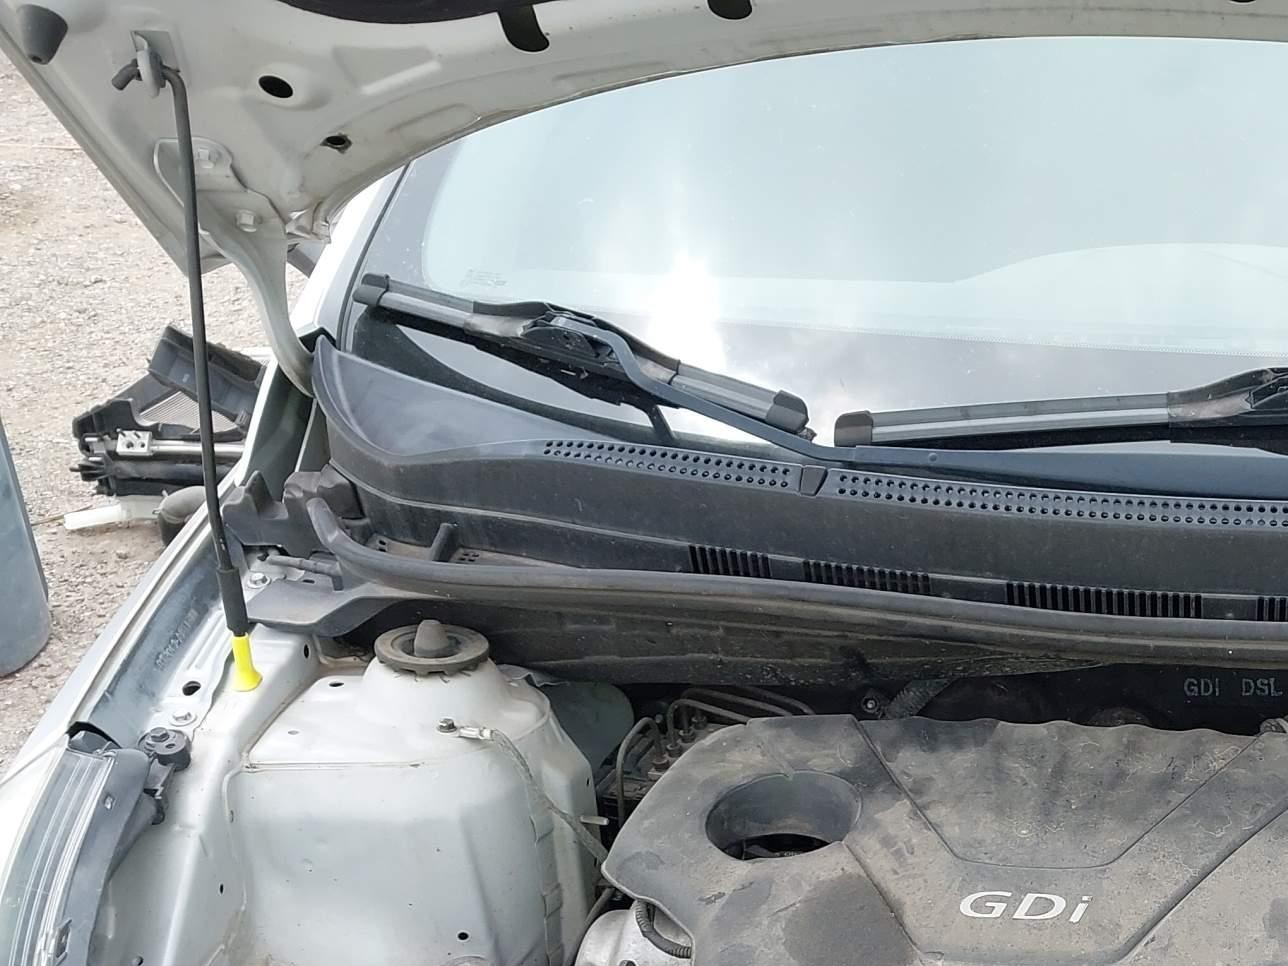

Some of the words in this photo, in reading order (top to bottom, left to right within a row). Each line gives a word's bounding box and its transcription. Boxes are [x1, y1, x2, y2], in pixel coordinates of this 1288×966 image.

[1184, 677, 1219, 696] GDI
[1242, 677, 1284, 696] DSL
[960, 890, 1094, 923] GDi
